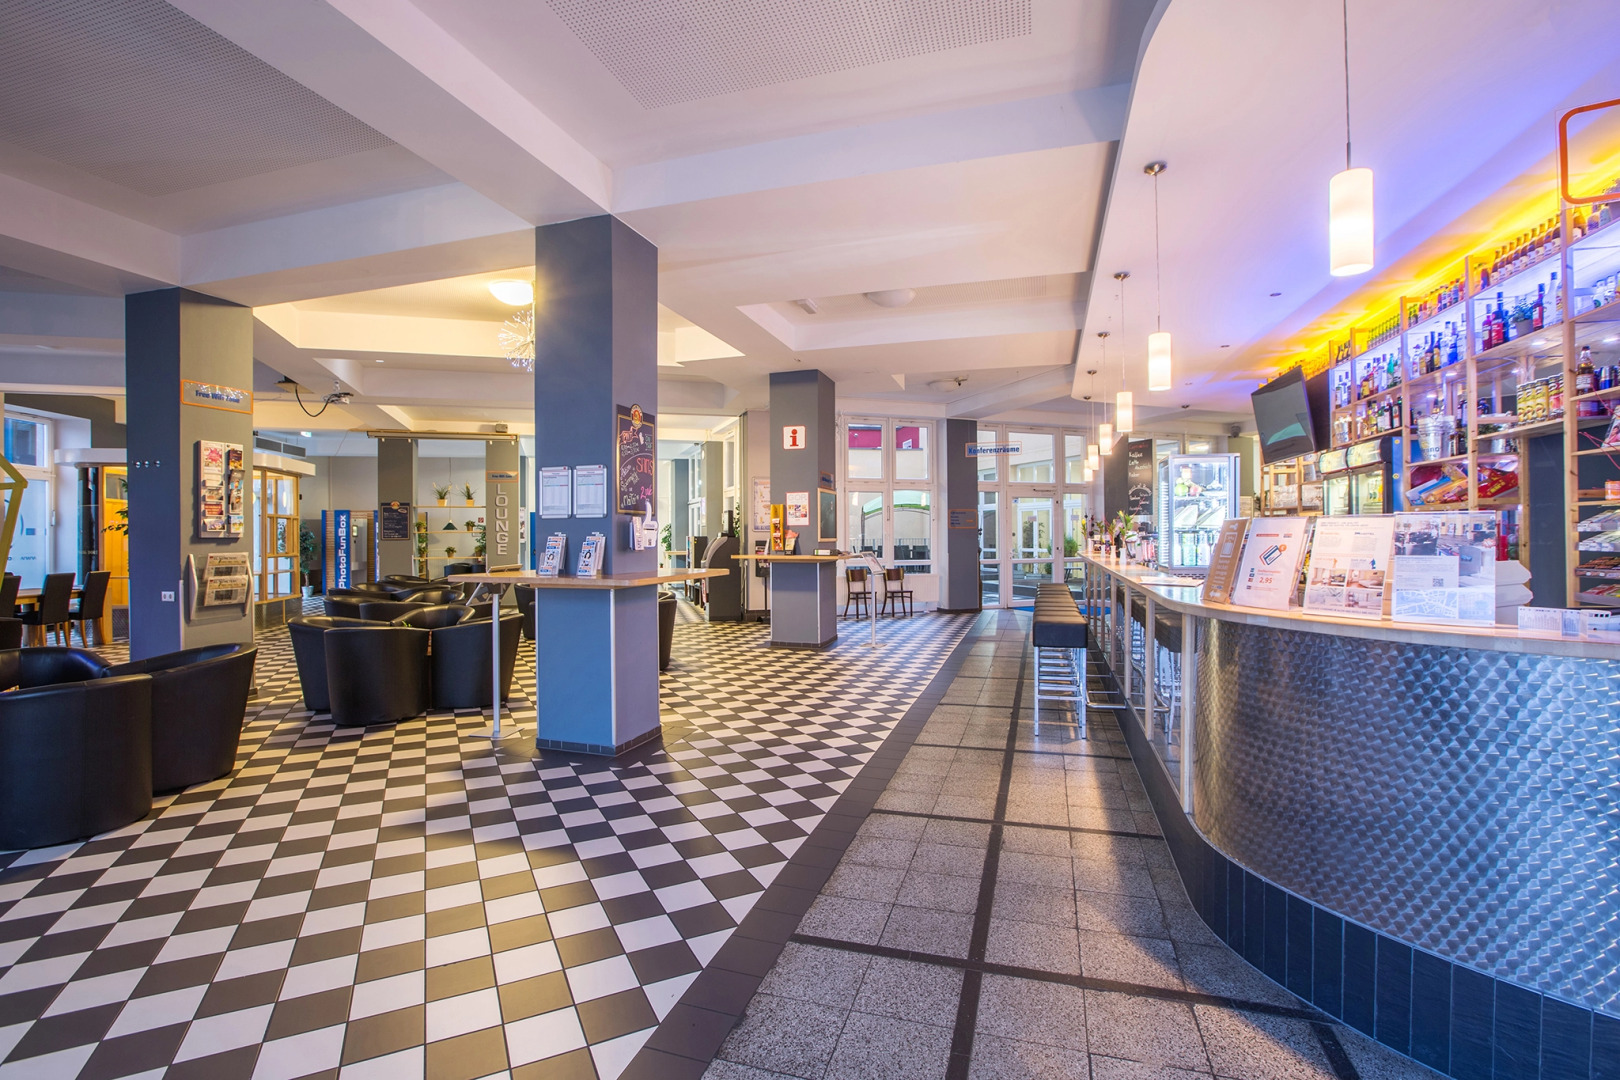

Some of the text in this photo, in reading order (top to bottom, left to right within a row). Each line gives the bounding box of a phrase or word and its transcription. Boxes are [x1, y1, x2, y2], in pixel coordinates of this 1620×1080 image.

[967, 446, 1020, 456] Konferenzräume
[496, 483, 509, 555] LOUNGE
[338, 514, 347, 589] PhotoFunBox
[1258, 576, 1273, 584] 2,95
